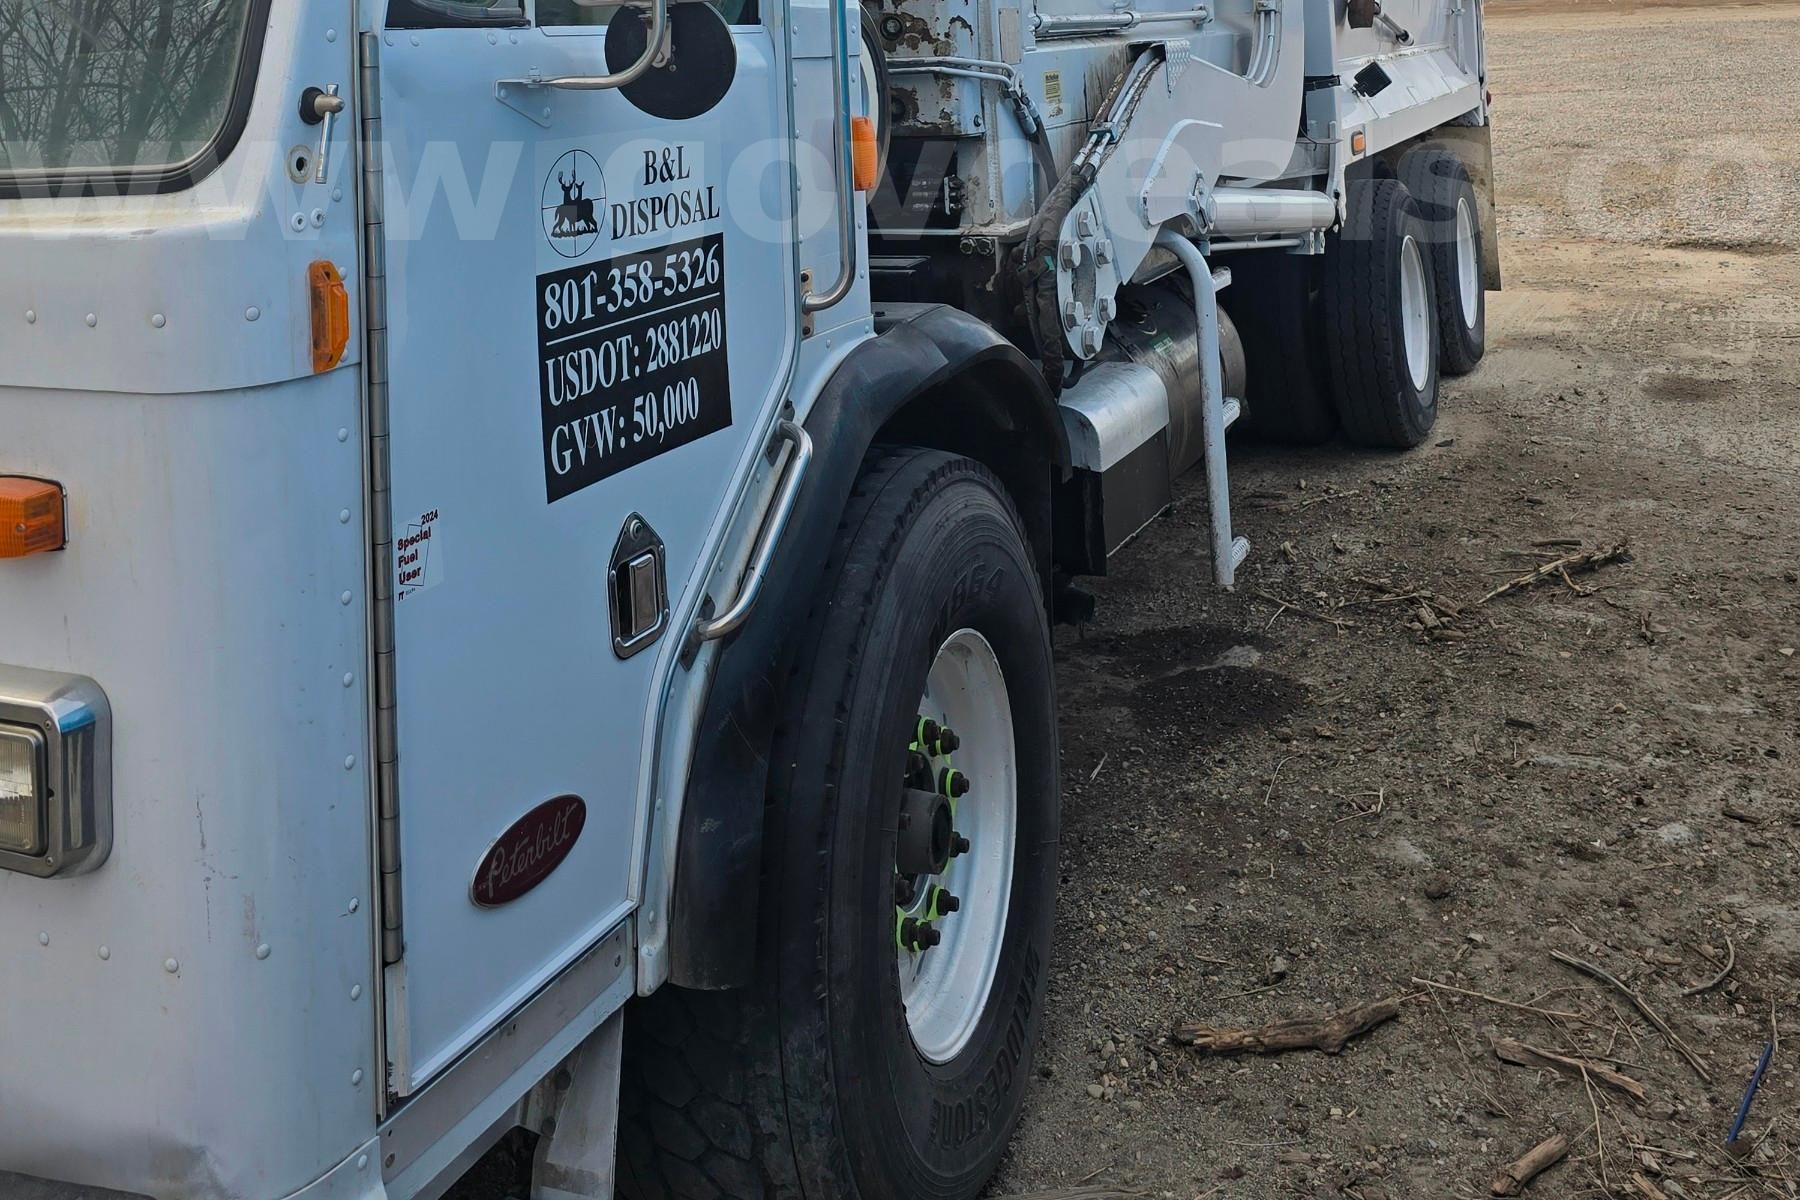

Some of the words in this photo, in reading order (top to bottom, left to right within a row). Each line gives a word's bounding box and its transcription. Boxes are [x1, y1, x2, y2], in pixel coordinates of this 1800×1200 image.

[643, 145, 691, 186] B&L
[610, 185, 721, 241] DISPOSAL
[544, 243, 720, 330] 801-358-5326
[545, 334, 641, 408] USDOT:
[645, 307, 722, 374] 2881220
[550, 405, 627, 476] GVW:
[632, 376, 700, 444] 50,000
[397, 525, 432, 552] Special
[421, 509, 439, 526] 2024
[398, 548, 419, 569] Fuel
[399, 566, 422, 586] User
[483, 802, 579, 899] Peterbilt
